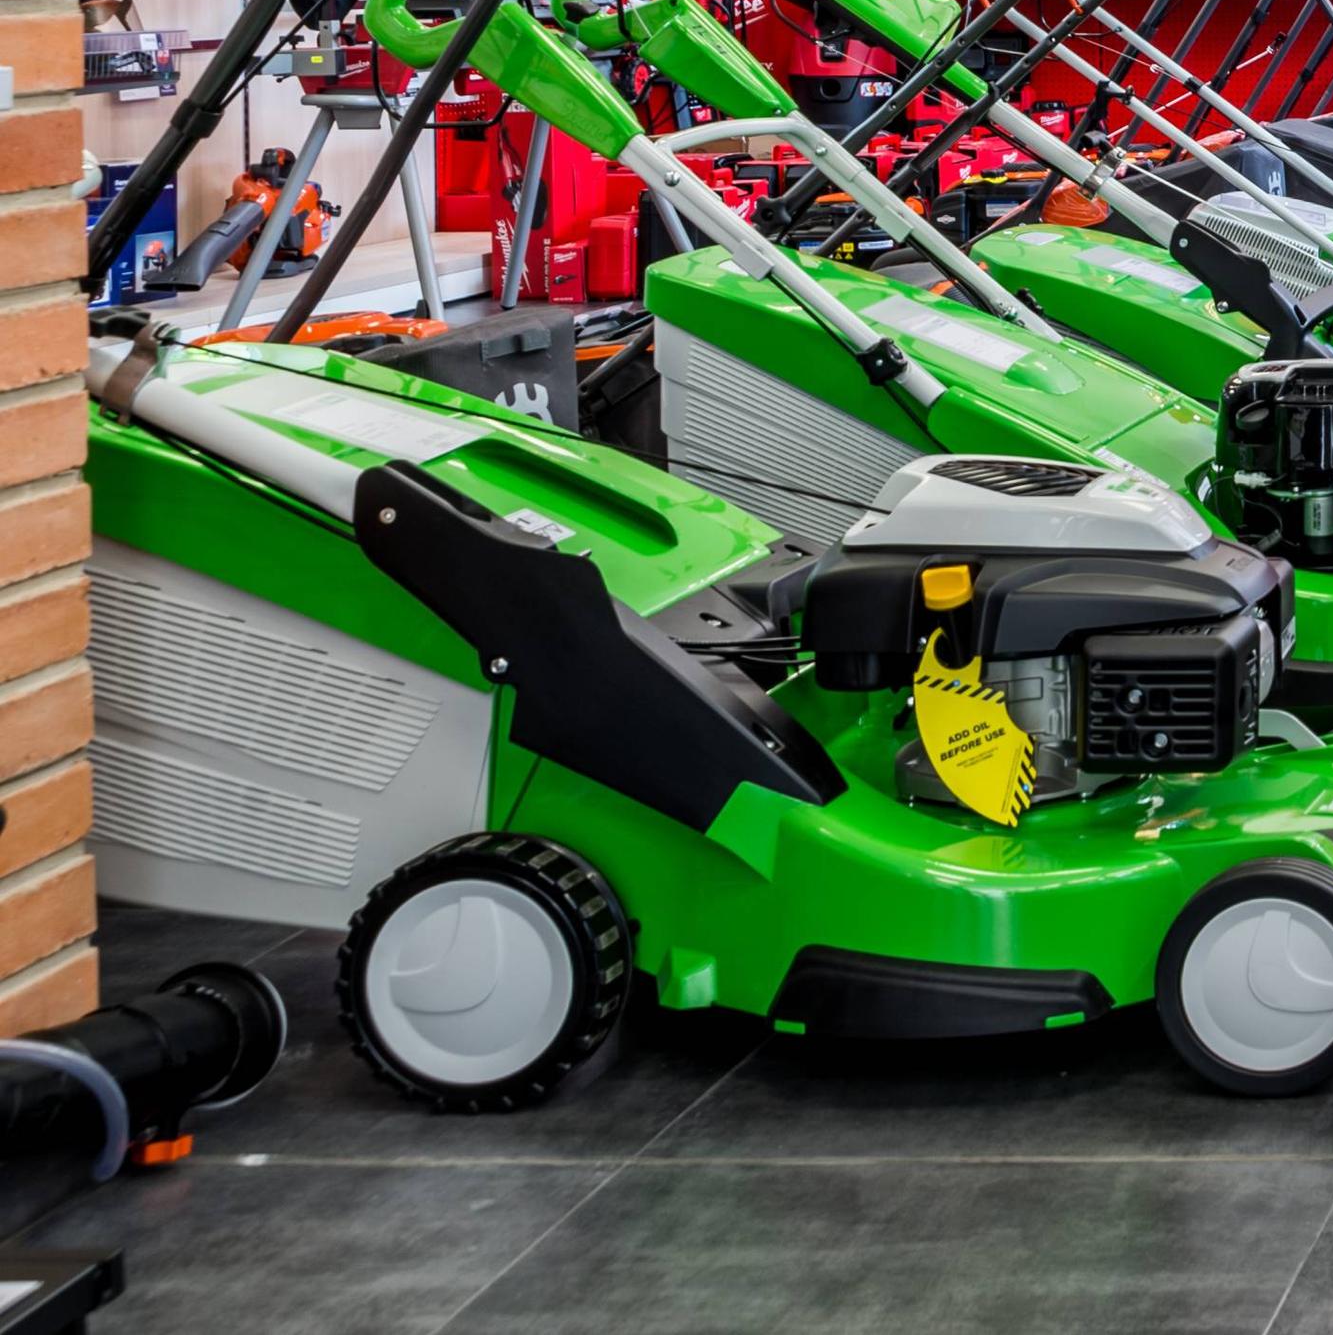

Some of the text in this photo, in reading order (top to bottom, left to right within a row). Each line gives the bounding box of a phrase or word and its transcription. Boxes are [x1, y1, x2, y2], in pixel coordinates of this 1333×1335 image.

[940, 738, 982, 762] BEFORE
[985, 727, 1006, 743] USE
[948, 722, 990, 745] ADD OIL
